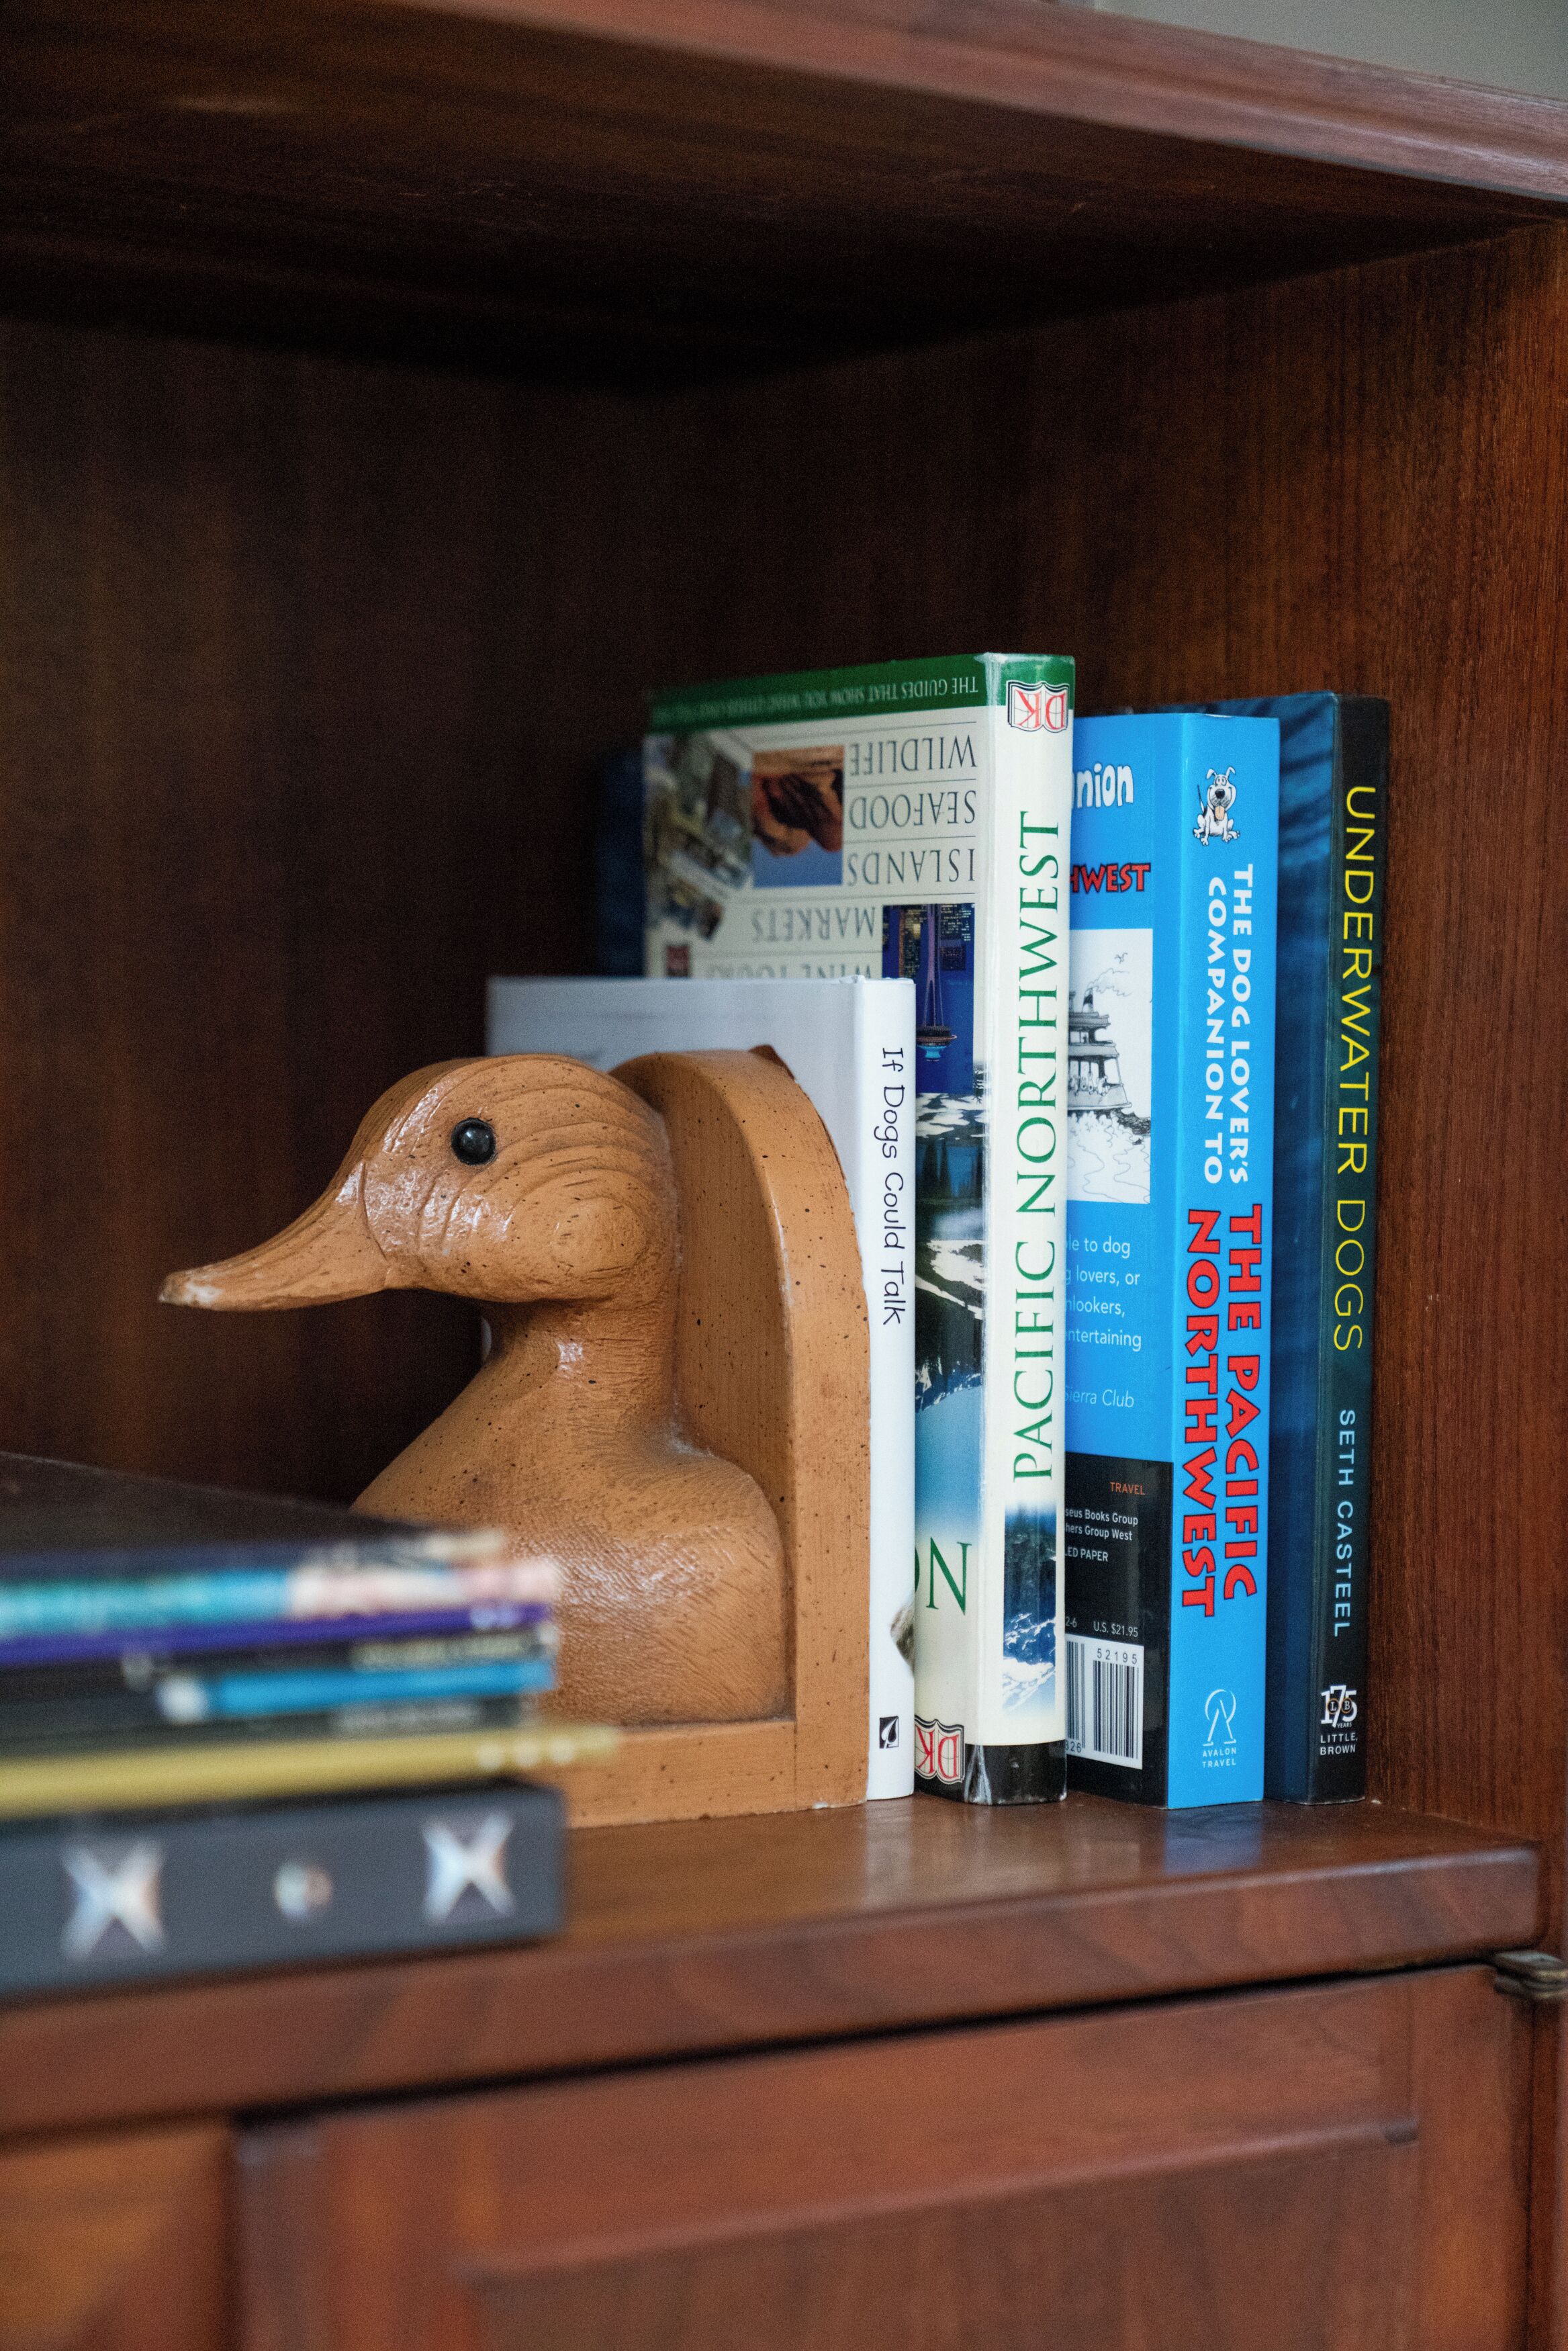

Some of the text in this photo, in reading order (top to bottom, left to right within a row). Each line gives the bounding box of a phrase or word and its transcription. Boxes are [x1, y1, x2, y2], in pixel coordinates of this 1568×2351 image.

[901, 678, 948, 700] GUIDES
[952, 676, 978, 695] THE
[1015, 690, 1066, 732] DK
[849, 735, 977, 776] WILDLIFE
[1072, 762, 1134, 808] nion
[849, 790, 976, 830] SEAFOOD
[847, 848, 975, 886] ISLANDS
[1233, 863, 1254, 936] THE
[751, 907, 876, 943] MARKETS
[1232, 948, 1252, 1028] DOG
[1204, 877, 1227, 1184] COMPANION TO
[1334, 786, 1376, 1351] UNDERWATER DOGS
[1013, 811, 1059, 1482] PACIFIC NORTHWEST
[874, 1047, 907, 1326] If Dogs Could Talk
[1083, 1237, 1098, 1252] to
[1103, 1236, 1131, 1259] dog
[1076, 1265, 1120, 1287] lovers,
[1125, 1273, 1141, 1285] or
[1066, 1329, 1142, 1352] ntertaining
[1101, 1388, 1135, 1409] Club
[1182, 1209, 1221, 1617] NORTHWEST
[1224, 1204, 1262, 1599] THE PACIFIC
[1110, 1481, 1146, 1496] TRAVEL
[1085, 1509, 1110, 1522] Books
[1112, 1513, 1138, 1527] Group
[1085, 1525, 1109, 1540] Group
[1111, 1529, 1133, 1541] West
[1334, 1409, 1356, 1637] SETH CASTEEL
[1080, 1548, 1109, 1562] PAPER
[1093, 1620, 1109, 1633] U.S.
[1111, 1623, 1138, 1638] $21.95
[915, 1725, 960, 1779] DK
[1202, 1747, 1237, 1758] AVALON
[1320, 1732, 1358, 1744] LITTLE,
[1320, 1744, 1356, 1755] BROWN
[1202, 1758, 1237, 1768] TRAVEL
